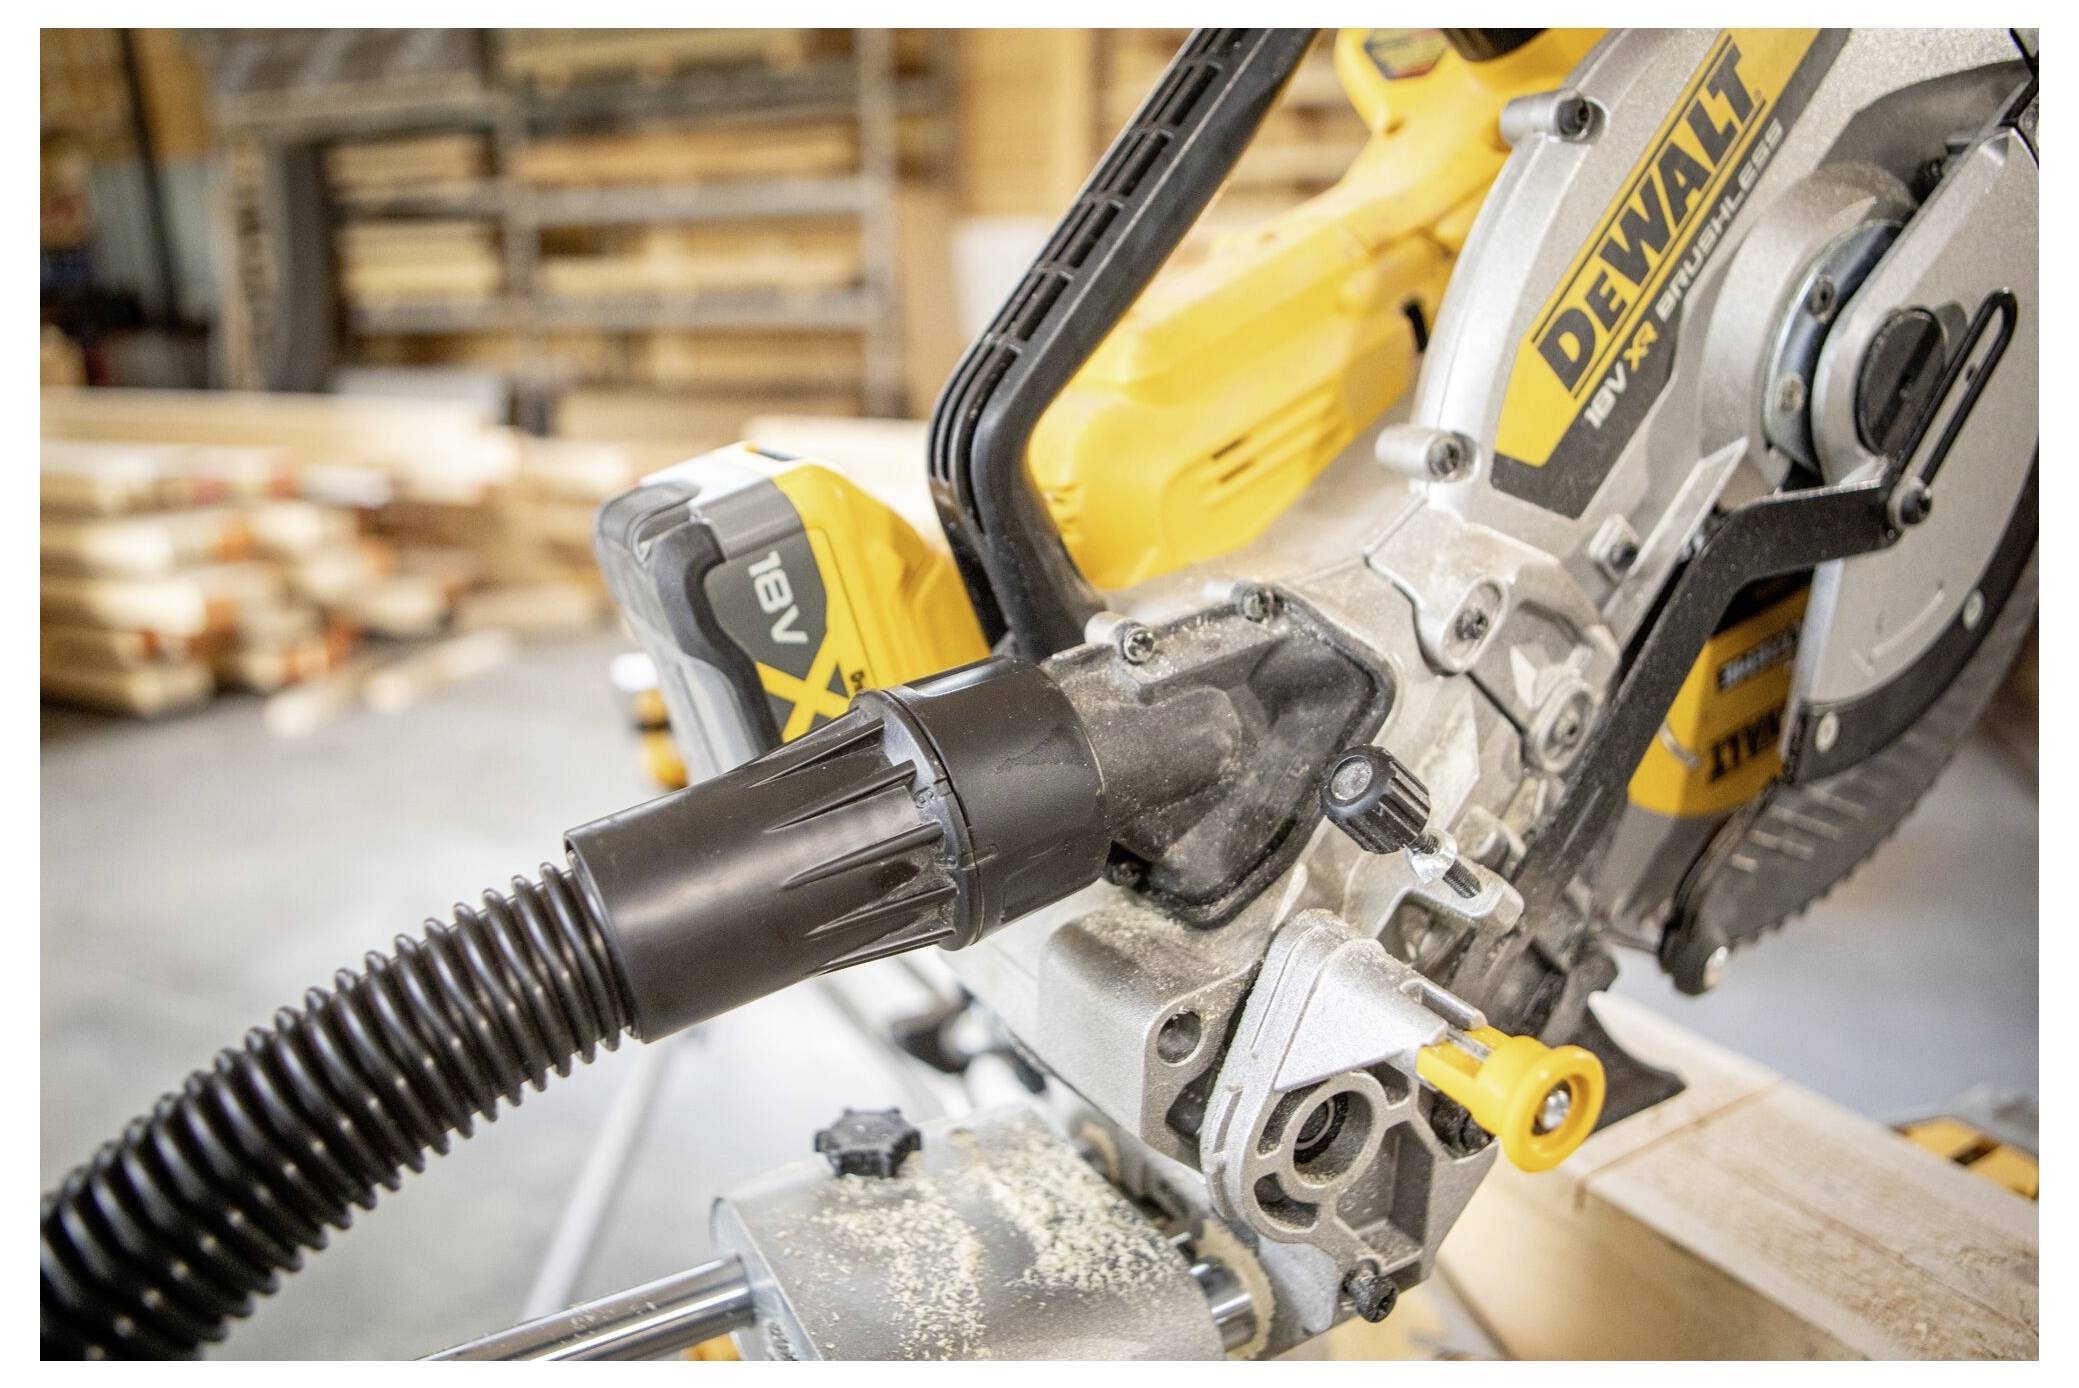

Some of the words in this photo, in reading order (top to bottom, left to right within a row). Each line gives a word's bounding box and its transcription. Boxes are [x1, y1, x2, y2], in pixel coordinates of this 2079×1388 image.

[1538, 42, 1753, 389] DEWALT
[1584, 360, 1627, 429] 18V
[1623, 320, 1658, 373] XR
[1655, 118, 1783, 322] BRUSHLESS
[748, 550, 809, 644] 18V
[755, 650, 850, 745] X
